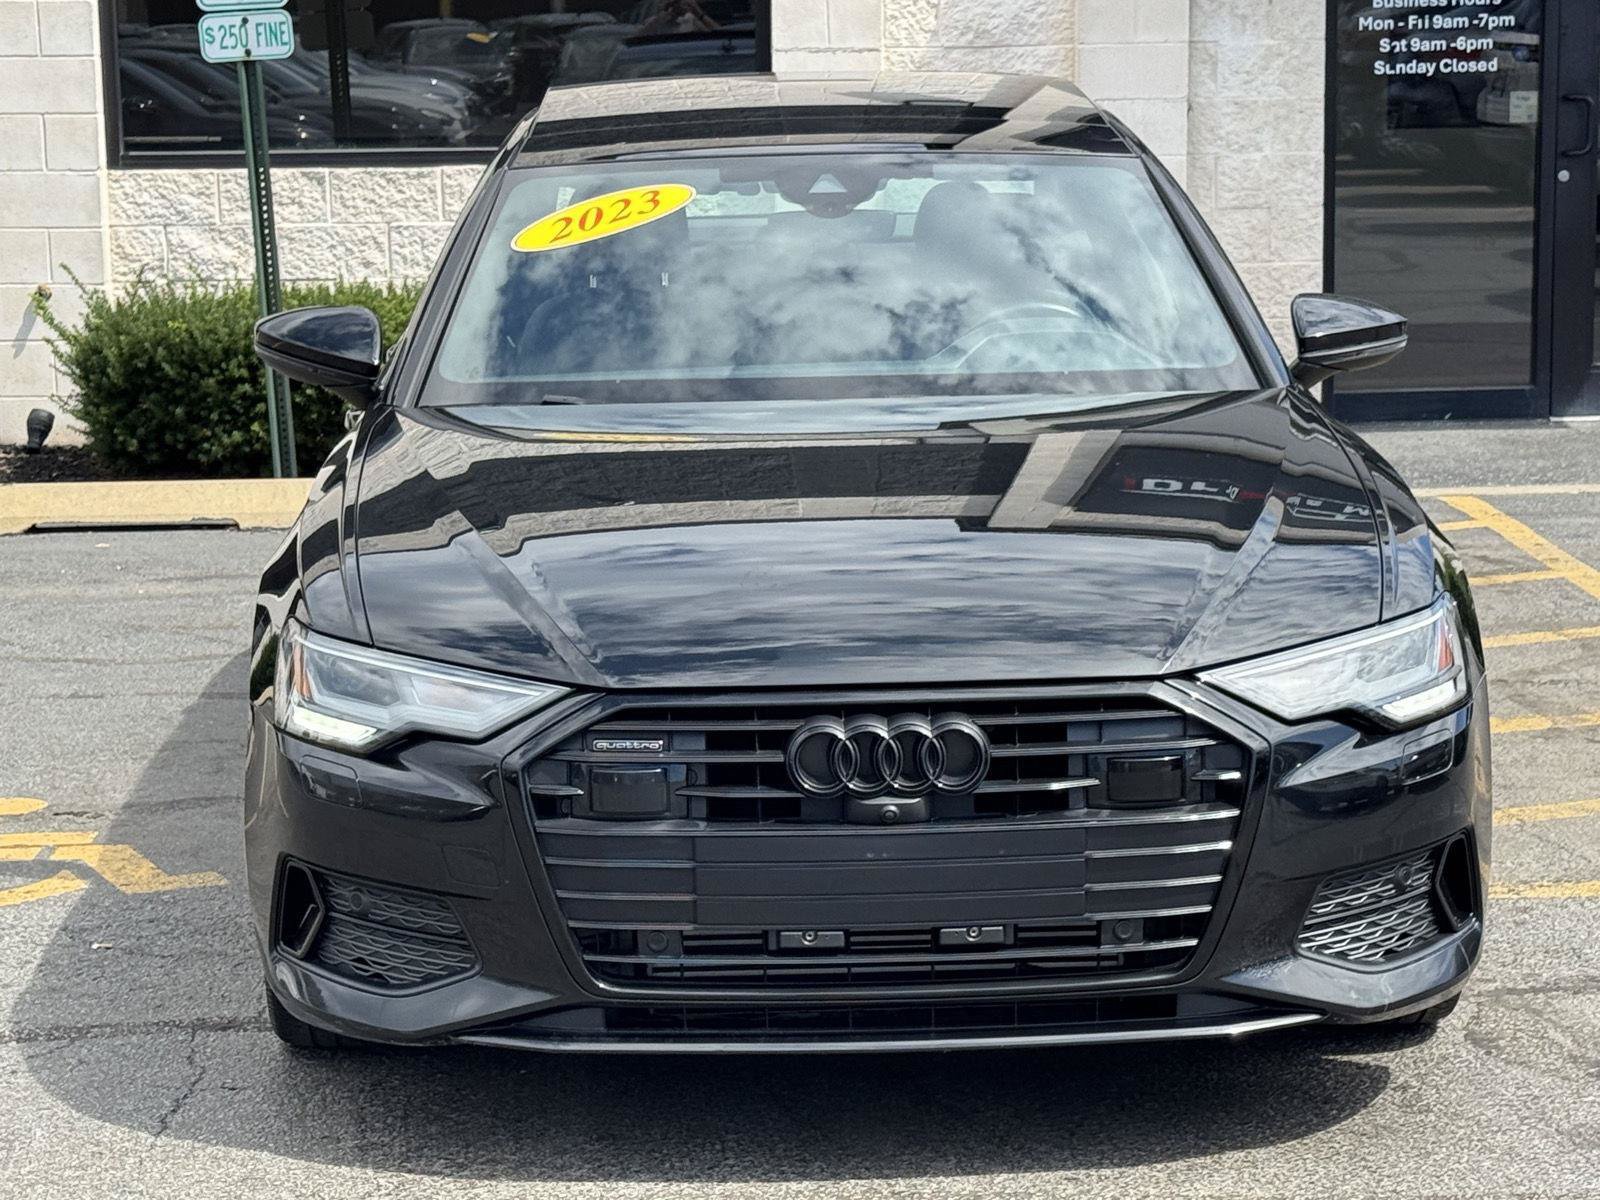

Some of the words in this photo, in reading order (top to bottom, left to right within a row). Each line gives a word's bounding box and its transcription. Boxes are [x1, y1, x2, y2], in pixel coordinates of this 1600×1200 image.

[1358, 16, 1394, 31] Mon
[1432, 15, 1469, 30] 9am
[1472, 13, 1515, 31] -7pm
[255, 21, 289, 47] FINE
[1410, 38, 1447, 51] 9am
[1450, 36, 1494, 53] -6pm
[1439, 57, 1498, 74] Closed
[549, 190, 661, 244] 2023
[596, 741, 660, 751] quattro
